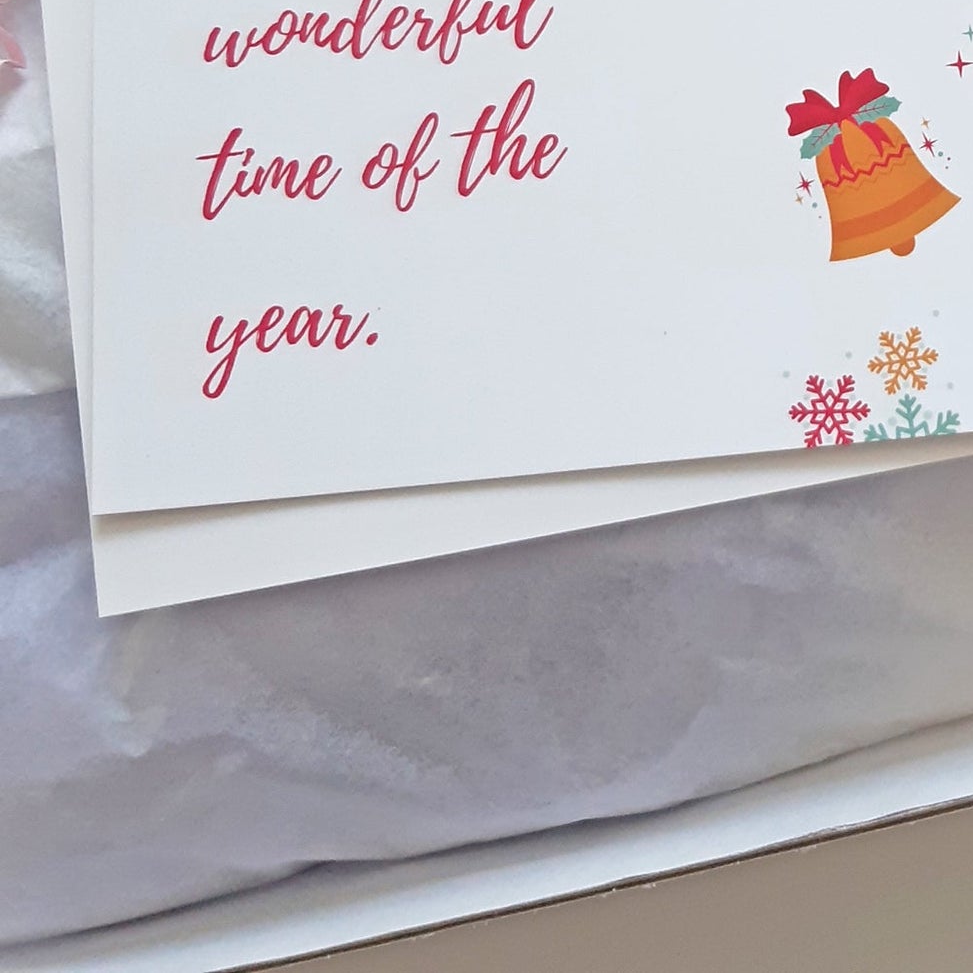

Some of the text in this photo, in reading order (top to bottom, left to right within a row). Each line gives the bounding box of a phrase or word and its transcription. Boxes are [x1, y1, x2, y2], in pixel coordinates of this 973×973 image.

[196, 79, 568, 221] time of the
[202, 303, 379, 400] year.
